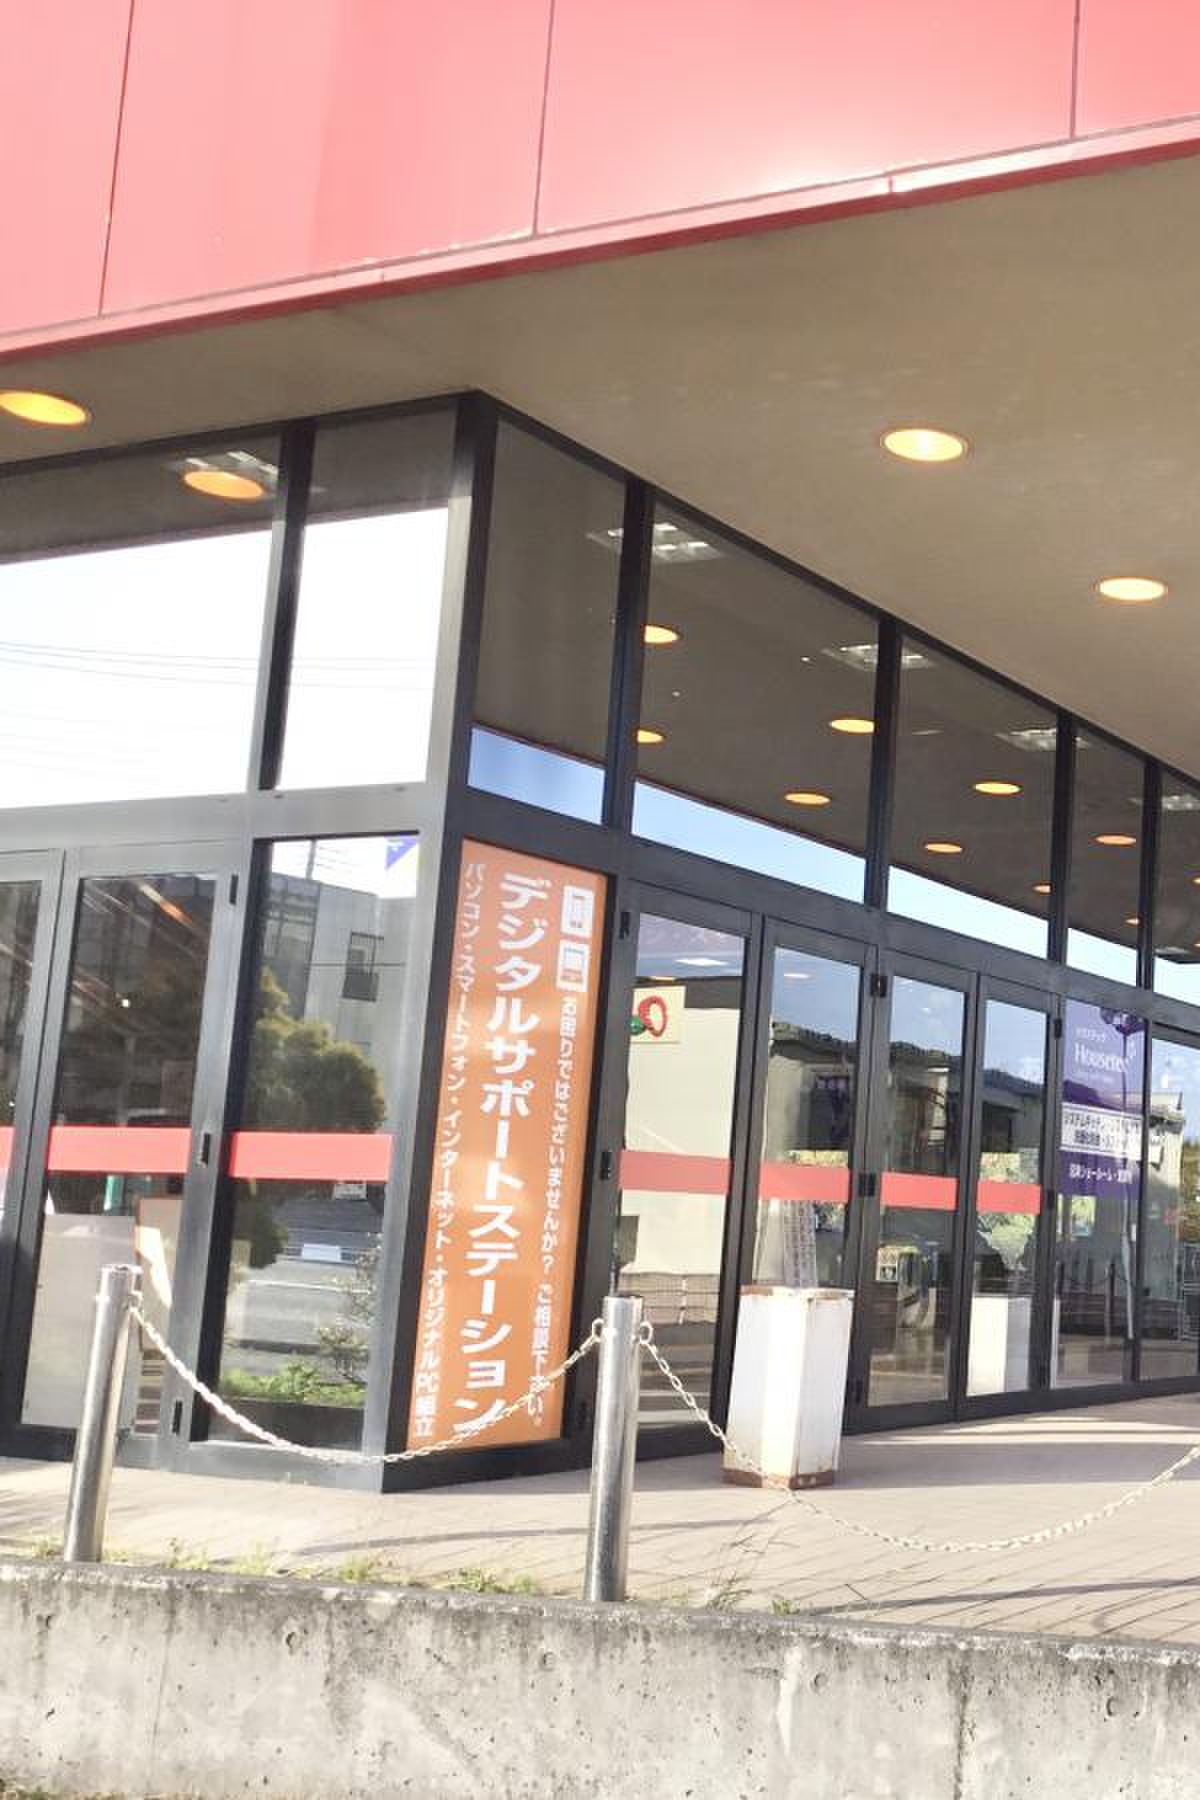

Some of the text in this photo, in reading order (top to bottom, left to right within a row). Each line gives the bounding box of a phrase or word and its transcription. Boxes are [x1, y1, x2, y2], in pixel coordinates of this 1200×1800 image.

[453, 871, 552, 1433] デジタルサポートステーション
